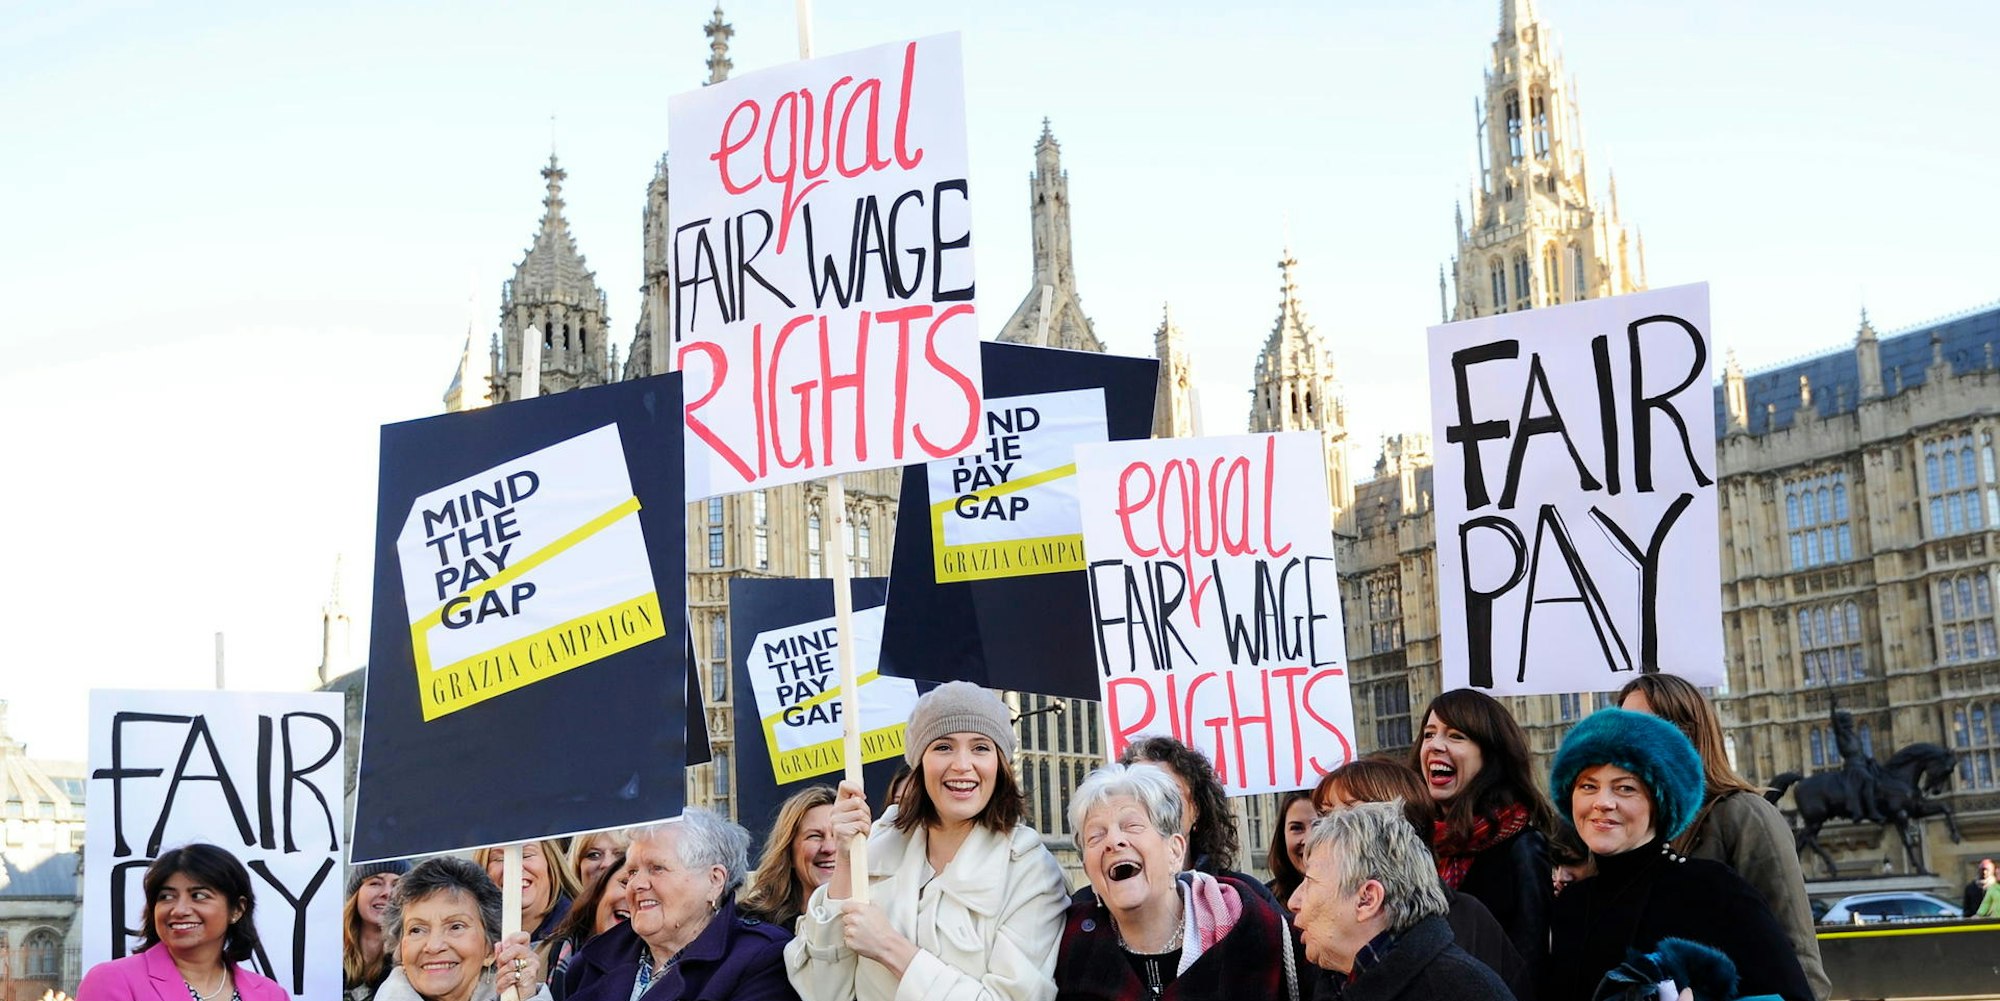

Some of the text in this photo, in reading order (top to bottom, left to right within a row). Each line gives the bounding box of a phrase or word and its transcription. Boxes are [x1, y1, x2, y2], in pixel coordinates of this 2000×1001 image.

[710, 41, 924, 254] equal
[673, 178, 976, 342] FAIR WAGE
[677, 303, 981, 483] RIGHTS
[987, 406, 1041, 436] ND
[1446, 314, 1714, 511] FAIR
[422, 470, 540, 539] MIND
[952, 462, 1015, 494] PAY
[954, 494, 1030, 522] GAP
[425, 507, 522, 567] THE
[943, 539, 1086, 575] GRAZIA CAMPAI
[1114, 434, 1292, 629] equal
[434, 542, 513, 601] PAY
[1458, 492, 1695, 689] PAY
[441, 582, 537, 630] GAP
[1089, 555, 1337, 677] FAIR WAGE
[432, 602, 655, 706] GRAZIA CAMPAIGN
[768, 651, 834, 684] THE
[776, 674, 829, 707] PAY
[92, 711, 342, 858] FAIR
[780, 745, 840, 776] GRAZIA
